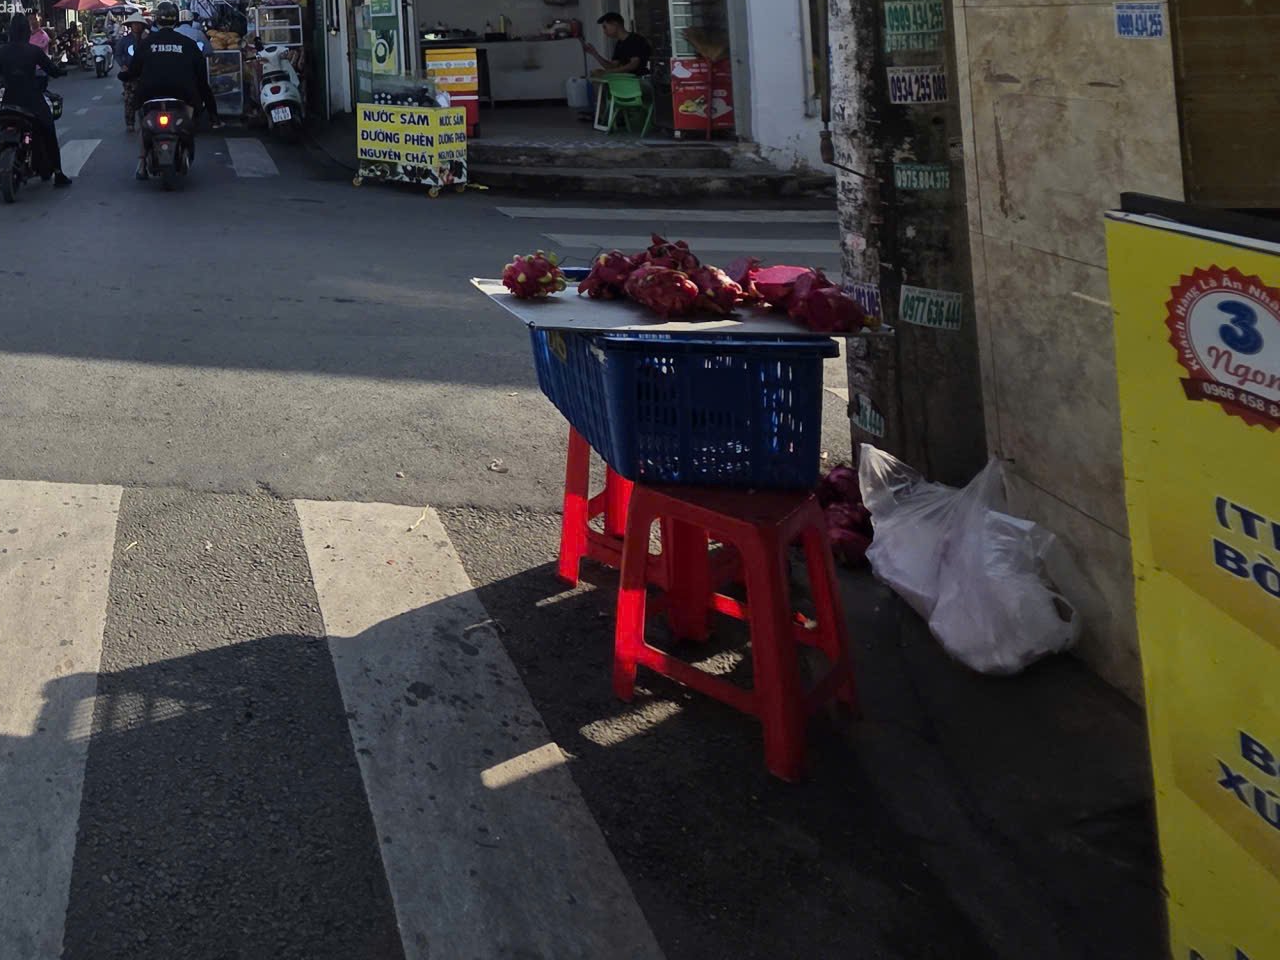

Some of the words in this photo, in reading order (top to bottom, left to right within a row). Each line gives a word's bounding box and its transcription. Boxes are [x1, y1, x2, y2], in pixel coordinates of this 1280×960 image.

[361, 128, 400, 144] ĐƯỜNG
[1217, 300, 1264, 355] 3
[1203, 382, 1235, 401] 0966
[1239, 393, 1265, 412] 458
[1269, 403, 1280, 418] 8
